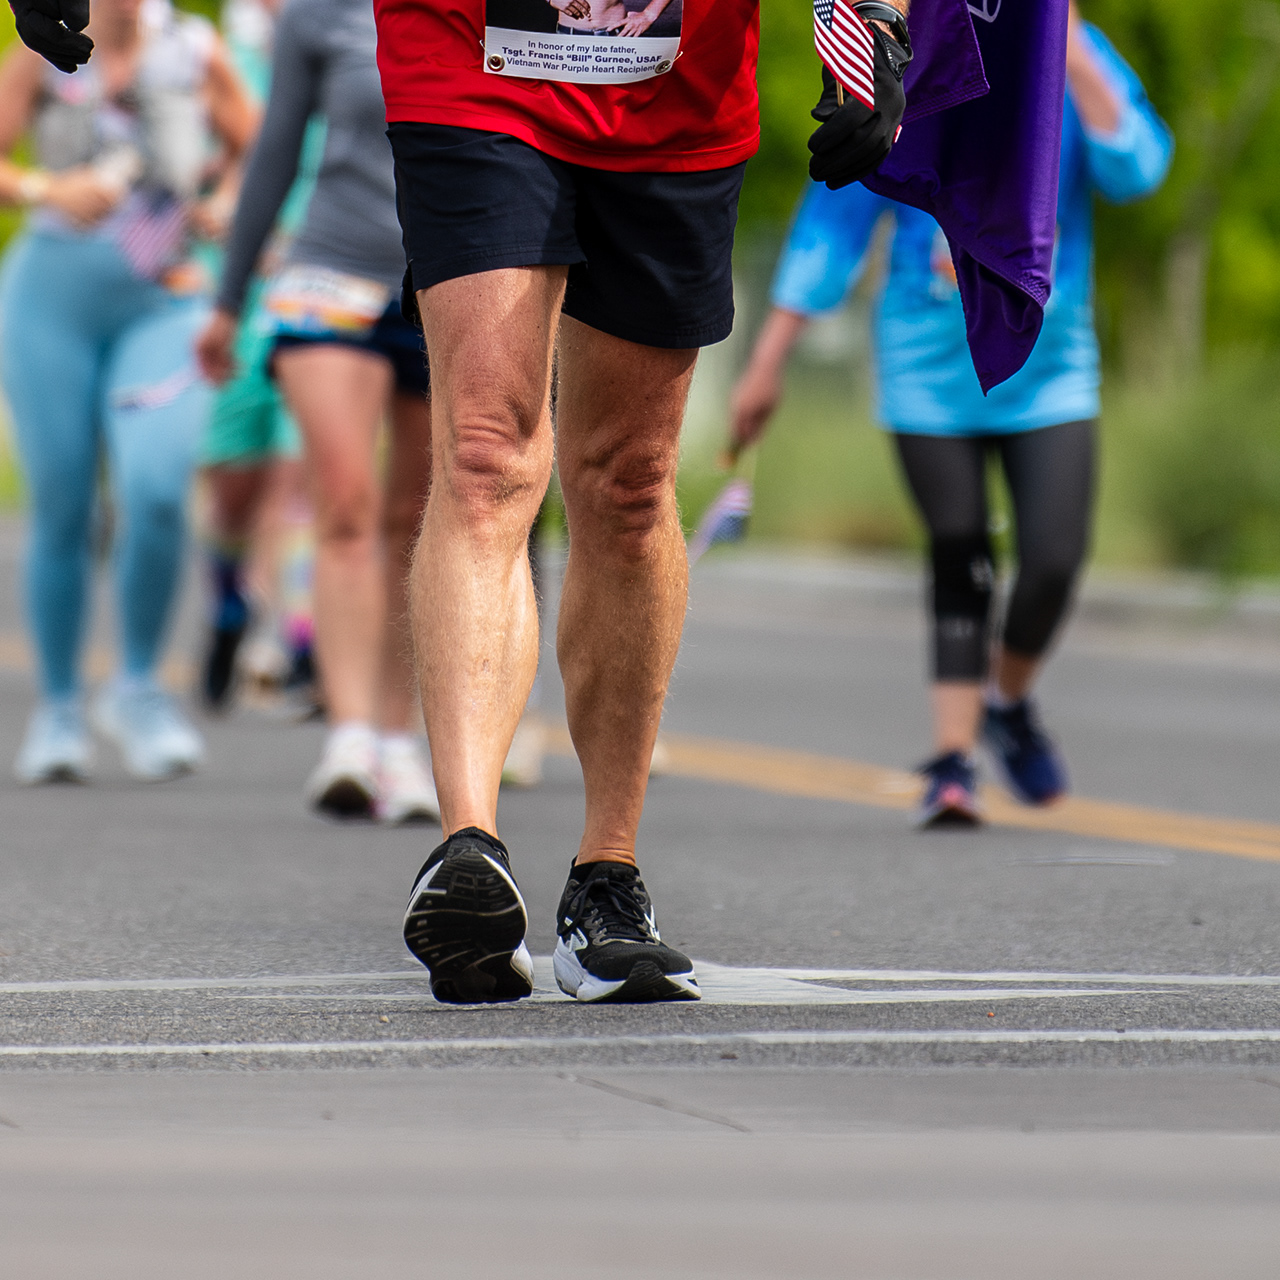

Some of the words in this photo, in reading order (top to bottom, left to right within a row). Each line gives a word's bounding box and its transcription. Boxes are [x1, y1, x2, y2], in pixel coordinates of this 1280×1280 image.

[502, 46, 526, 57] Tsgt.
[528, 50, 564, 61] Francis
[595, 55, 634, 65] Gurnee,
[636, 55, 663, 64] USAF
[527, 40, 536, 49] In
[538, 41, 565, 51] honor
[566, 44, 575, 52] of
[577, 46, 591, 54] my
[592, 45, 608, 54] late
[610, 45, 638, 55] father,
[506, 57, 541, 68] Vietnam
[543, 61, 560, 71] War
[561, 64, 590, 74] Purple
[591, 65, 615, 74] Heart
[617, 64, 656, 75] Recipient
